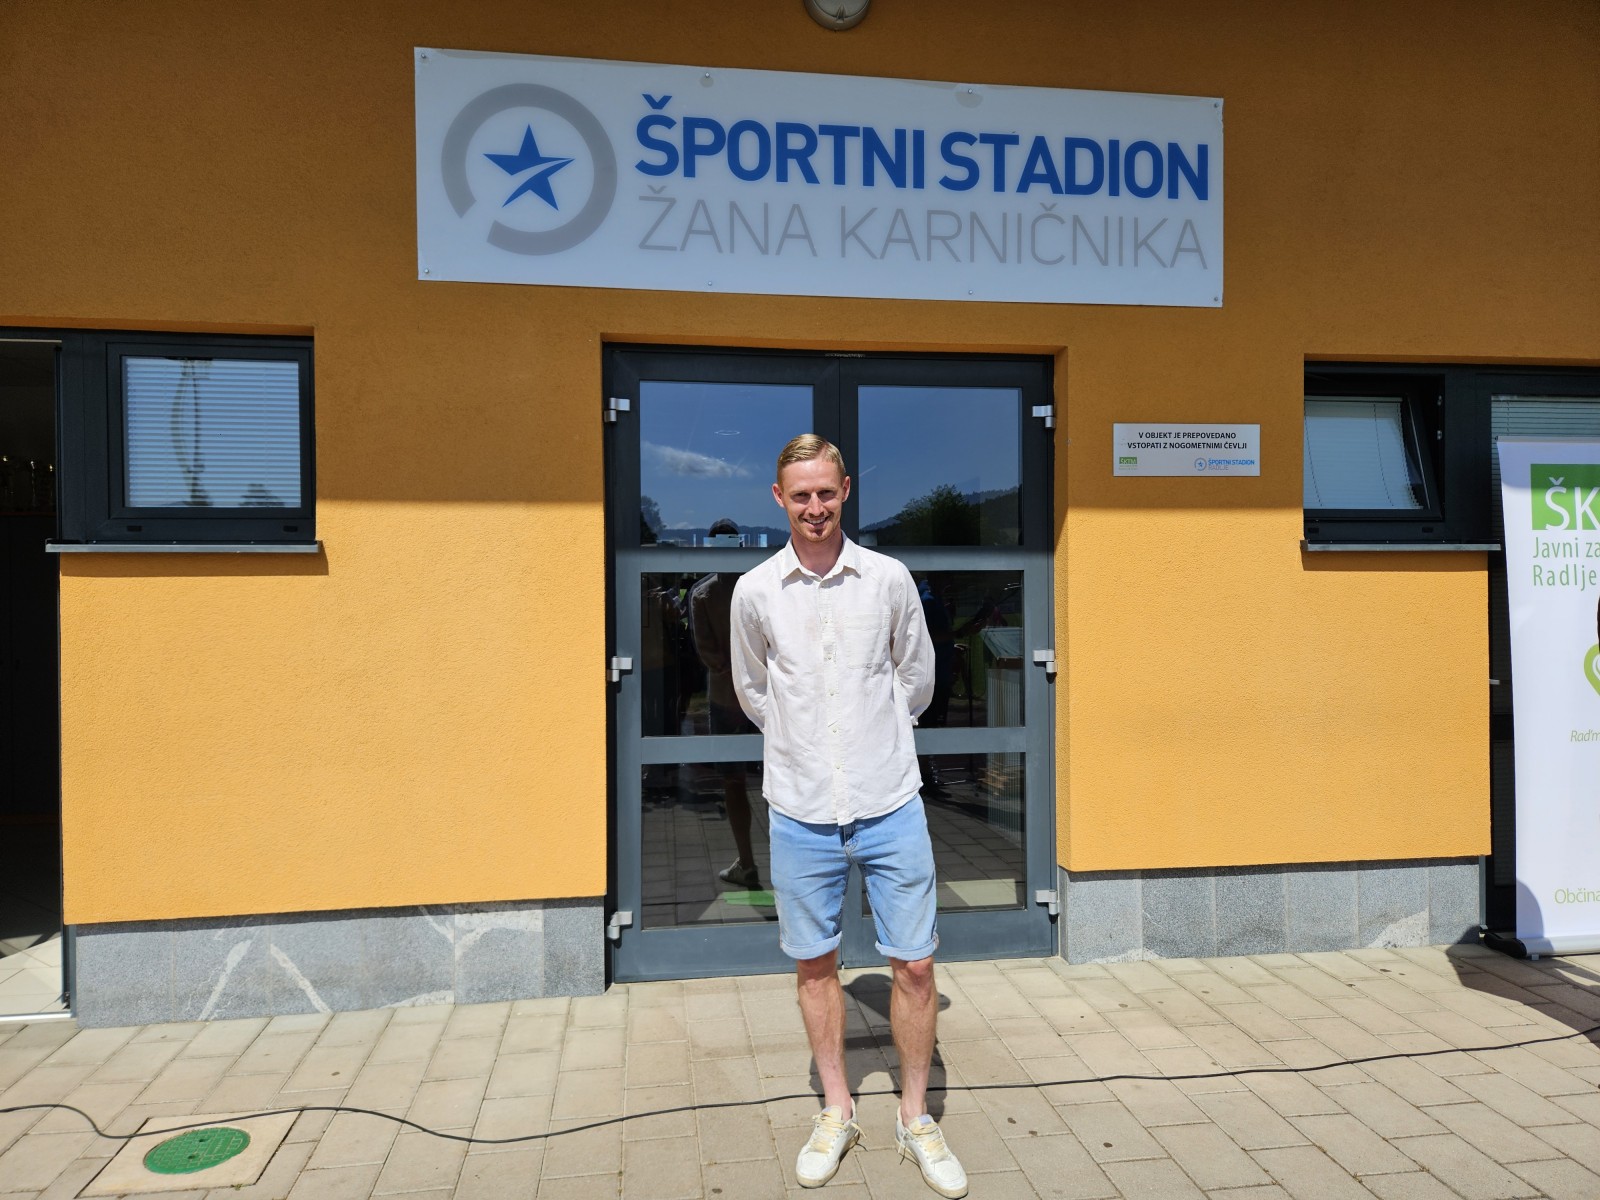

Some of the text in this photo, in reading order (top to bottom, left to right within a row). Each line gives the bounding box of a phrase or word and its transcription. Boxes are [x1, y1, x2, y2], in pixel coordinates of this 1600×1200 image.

[635, 94, 1209, 200] ŠPORTNI STADION
[637, 186, 1208, 270] ŽANA KARNIČNIKA
[1223, 441, 1247, 450] ČEVLJI
[1533, 537, 1579, 558] Javni
[1533, 564, 1597, 591] Radlje
